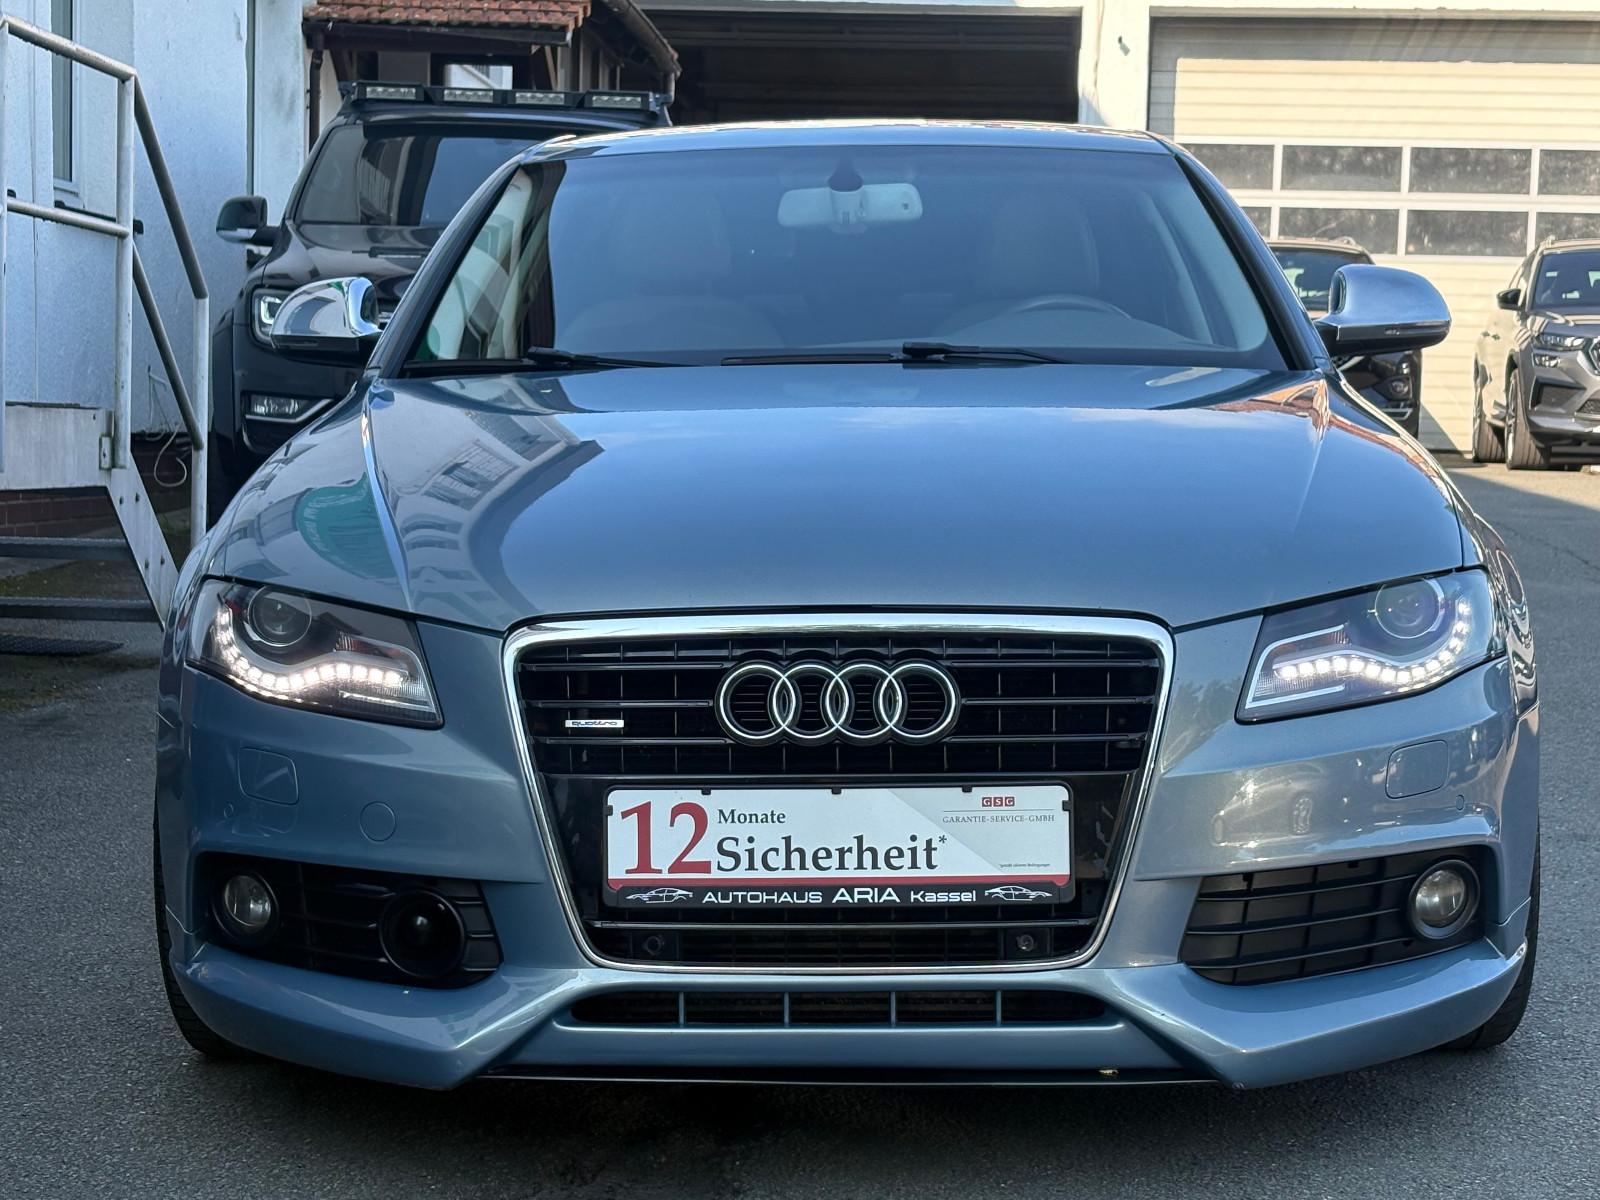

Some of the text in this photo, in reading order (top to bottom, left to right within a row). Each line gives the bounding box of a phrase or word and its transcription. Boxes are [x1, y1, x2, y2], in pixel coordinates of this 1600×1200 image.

[982, 797, 1015, 807] GSG
[717, 809, 786, 824] Monate
[942, 814, 1055, 823] GARANTIE-SERVICE-GMBH
[620, 801, 712, 875] 12
[702, 887, 976, 904] AUTOHAUS ARIA Kassel
